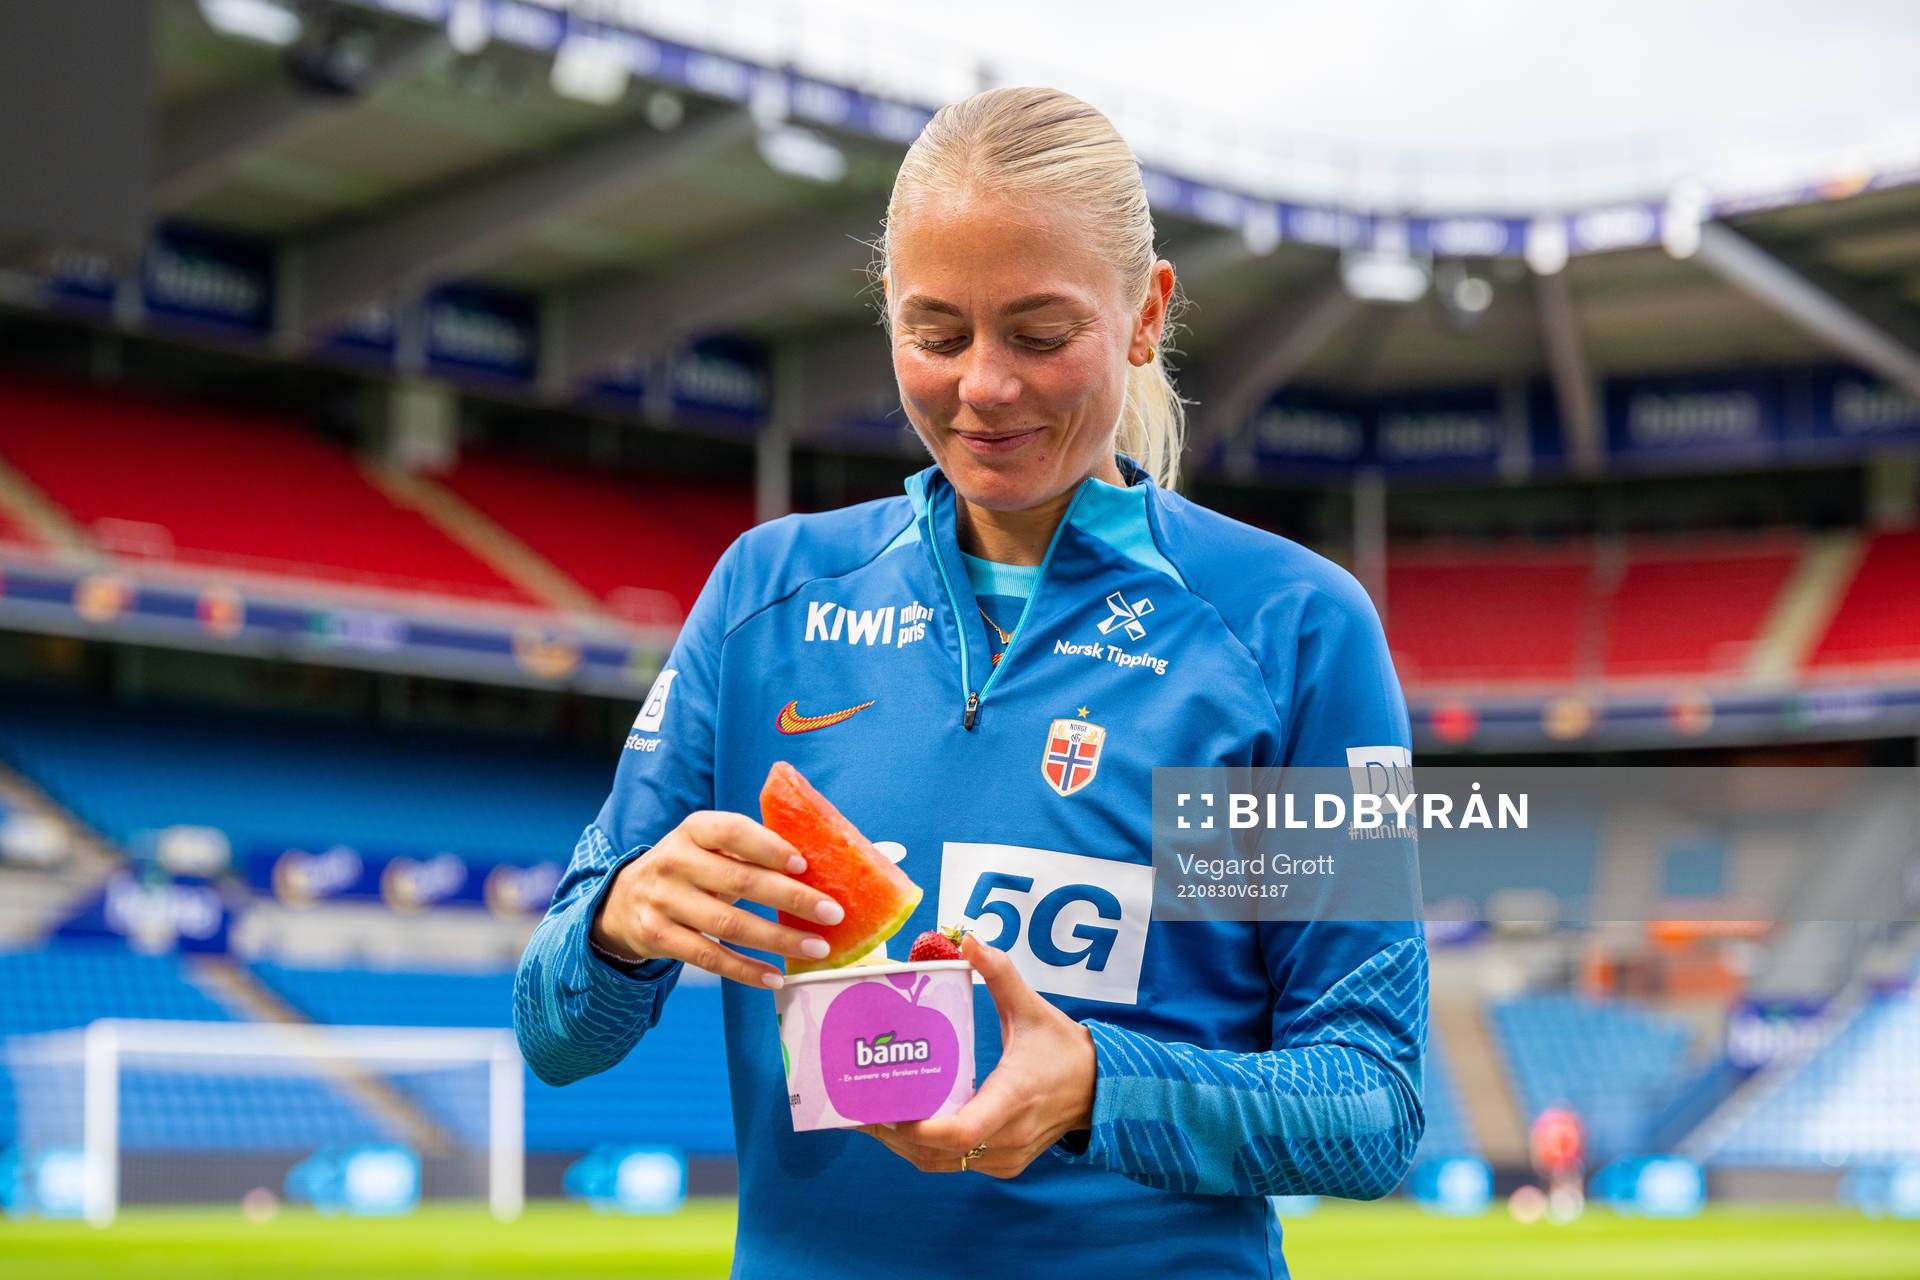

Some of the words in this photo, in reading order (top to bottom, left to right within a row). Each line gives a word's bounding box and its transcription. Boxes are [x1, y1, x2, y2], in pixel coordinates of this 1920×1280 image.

[804, 601, 896, 646] KIWI
[900, 600, 934, 624] mini
[897, 620, 926, 649] pris
[1053, 639, 1104, 659] Norsk
[1106, 644, 1169, 676] Tipping
[963, 871, 1122, 972] 5G
